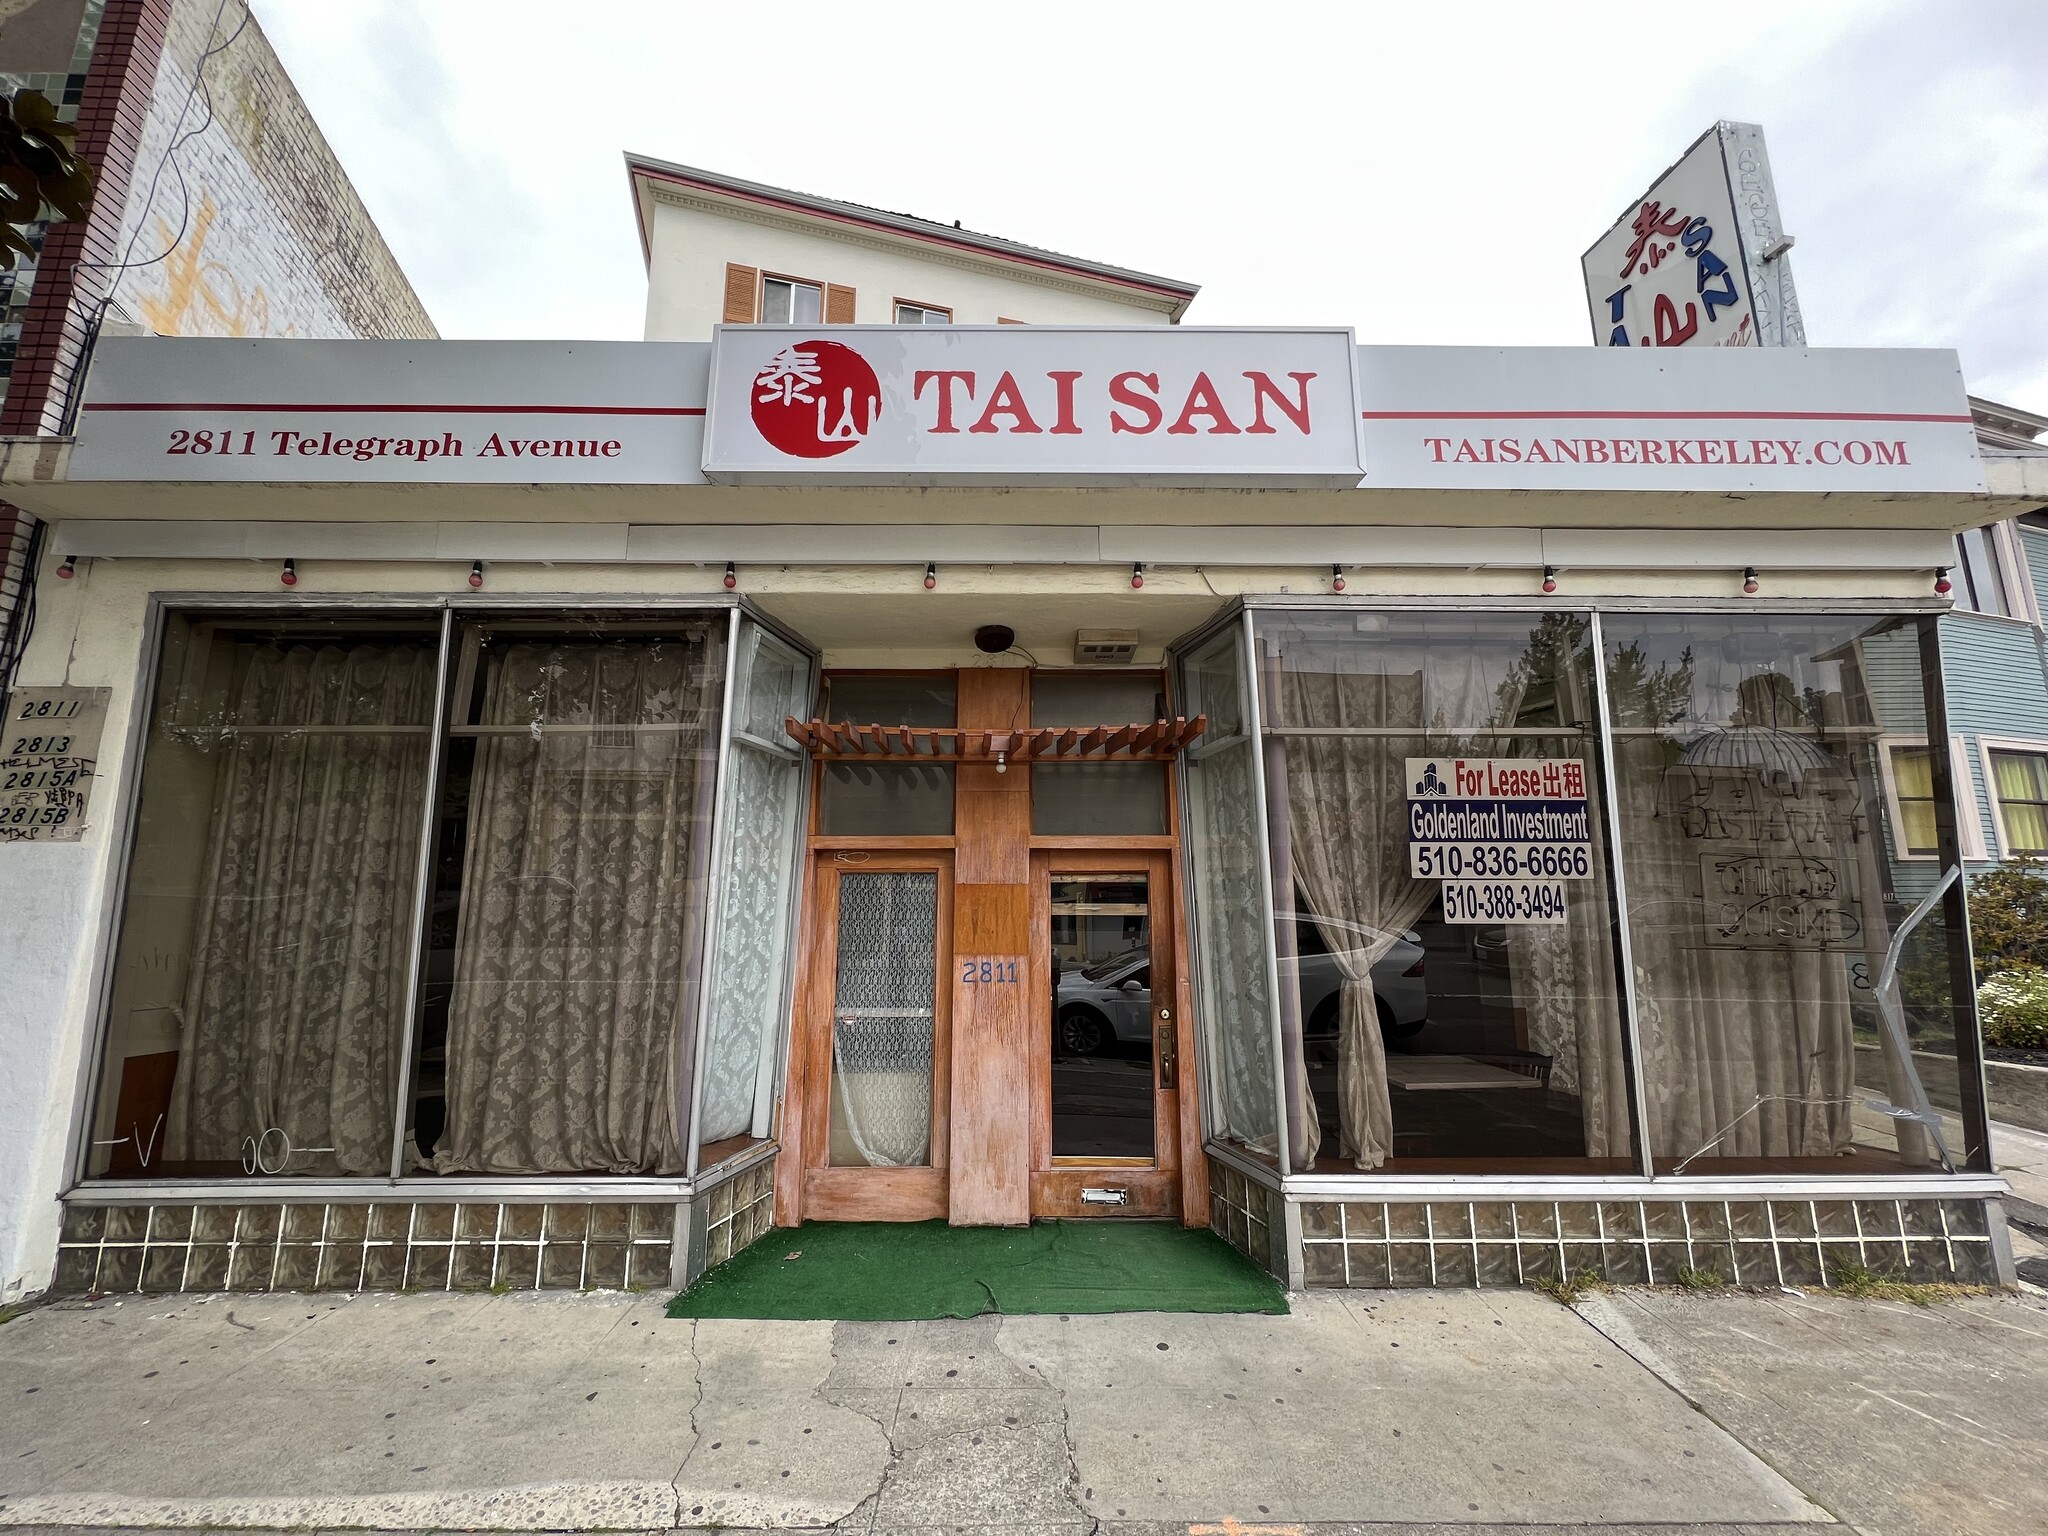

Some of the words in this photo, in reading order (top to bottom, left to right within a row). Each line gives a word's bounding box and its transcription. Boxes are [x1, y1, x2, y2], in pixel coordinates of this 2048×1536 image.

[1680, 216, 1738, 322] SAN
[914, 370, 1083, 434] TAI
[1109, 371, 1318, 435] SAN
[166, 429, 257, 456] 2811
[270, 431, 463, 461] Telegraph
[476, 432, 622, 458] Avenue
[1423, 437, 1912, 466] TAISANBERKELEY.COM
[20, 701, 79, 718] 2811
[12, 736, 70, 755] 2813
[4, 770, 78, 789] 2815A
[1455, 761, 1484, 796] For
[1487, 761, 1541, 797] Lease
[1542, 762, 1585, 798] 出租
[0, 807, 69, 825] 2815B
[1411, 803, 1500, 839] Goldenland
[1502, 803, 1589, 839] Investment
[1418, 846, 1589, 876] 510-836-6666
[1446, 884, 1565, 919] 510-388-3494
[962, 962, 1018, 983] 2811
